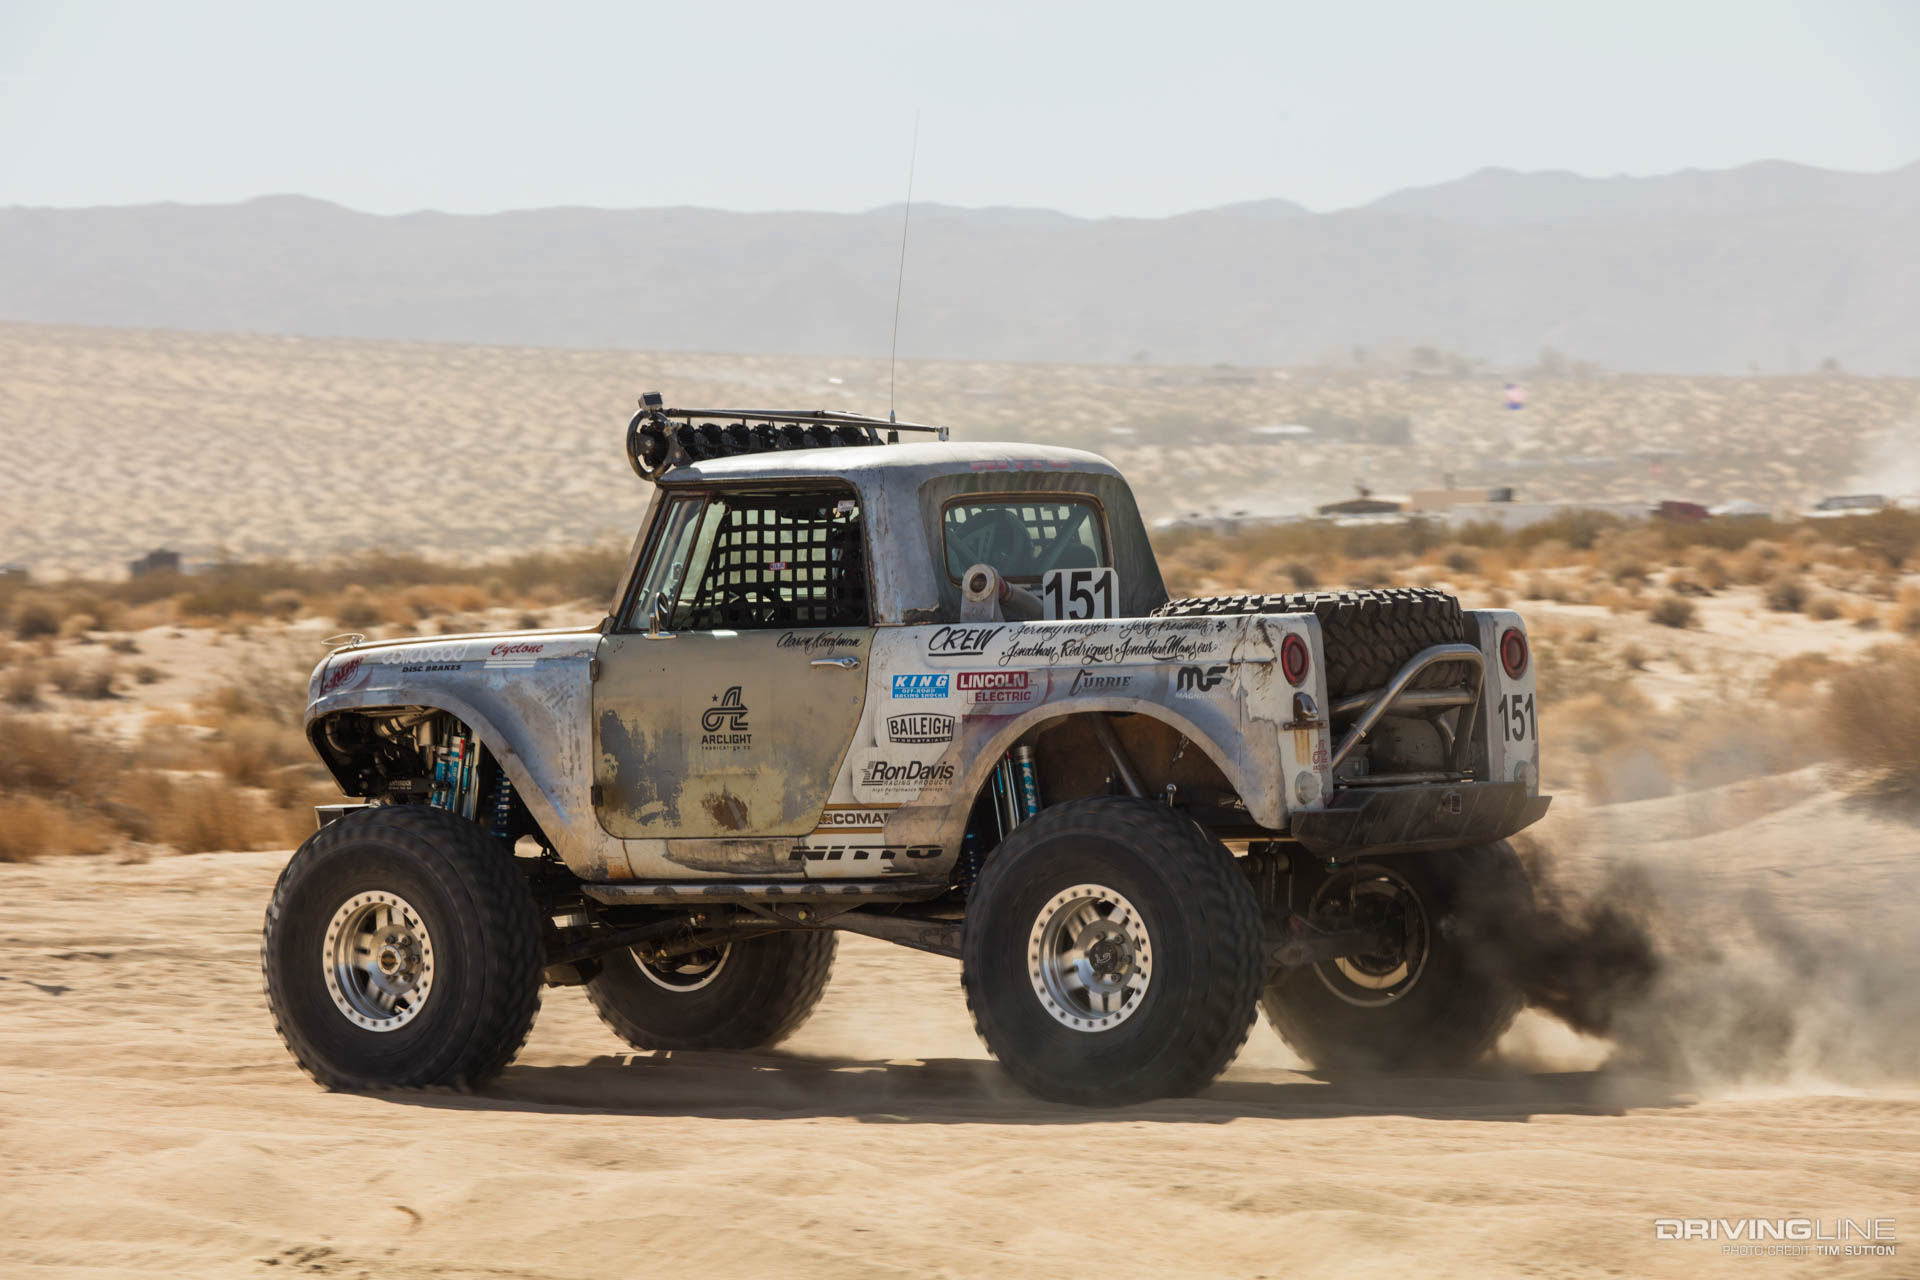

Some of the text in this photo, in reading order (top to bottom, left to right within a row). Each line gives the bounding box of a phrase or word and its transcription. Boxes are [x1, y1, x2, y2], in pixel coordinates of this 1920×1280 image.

[1045, 570, 1112, 620] 151
[928, 626, 1005, 652] CREW
[491, 642, 544, 657] Cyclone
[896, 675, 947, 687] KING
[960, 673, 1025, 688] LINCOLN
[1069, 669, 1131, 696] CURRIE
[975, 691, 1032, 702] ELECTRIC
[1498, 693, 1535, 742] 151
[890, 717, 952, 735] BAILEIGH
[701, 734, 752, 744] ARCLIGHT
